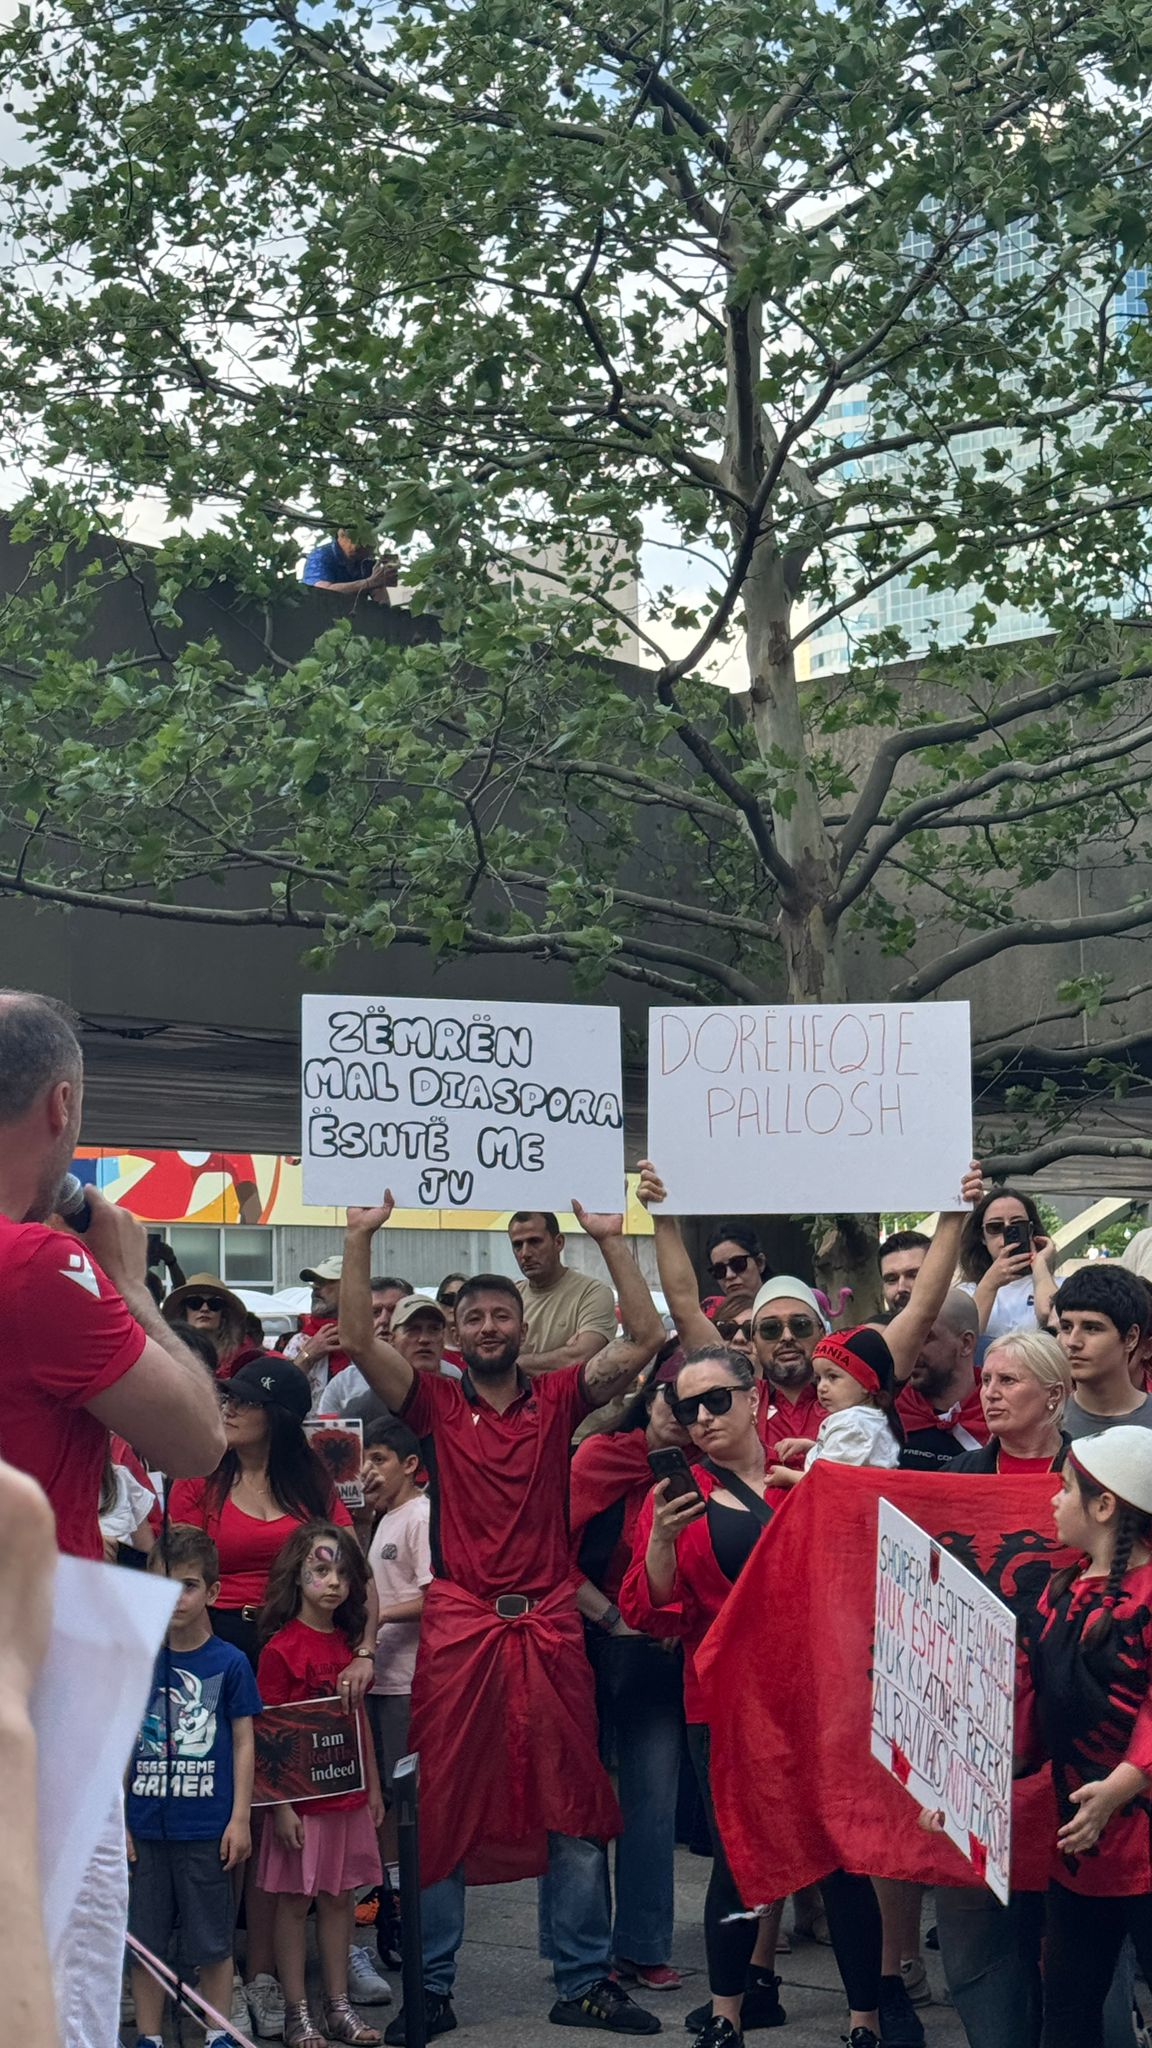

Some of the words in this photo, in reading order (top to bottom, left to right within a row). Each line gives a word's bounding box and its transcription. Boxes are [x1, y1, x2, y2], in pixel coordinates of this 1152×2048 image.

[329, 1005, 533, 1068] ZËMRËN
[304, 1057, 399, 1101] MAL
[410, 1067, 623, 1129] DIASPORA
[707, 1081, 904, 1138] PALLOSH
[309, 1106, 449, 1162] ËSHTË
[477, 1126, 545, 1172] ME
[418, 1167, 474, 1205] JU
[878, 1571, 905, 1642] NUK
[875, 1620, 904, 1686] NUK
[908, 1648, 923, 1701] KA
[923, 1671, 959, 1741] ATDHE
[311, 1733, 319, 1748] I
[321, 1733, 344, 1747] am
[311, 1760, 355, 1782] indeed
